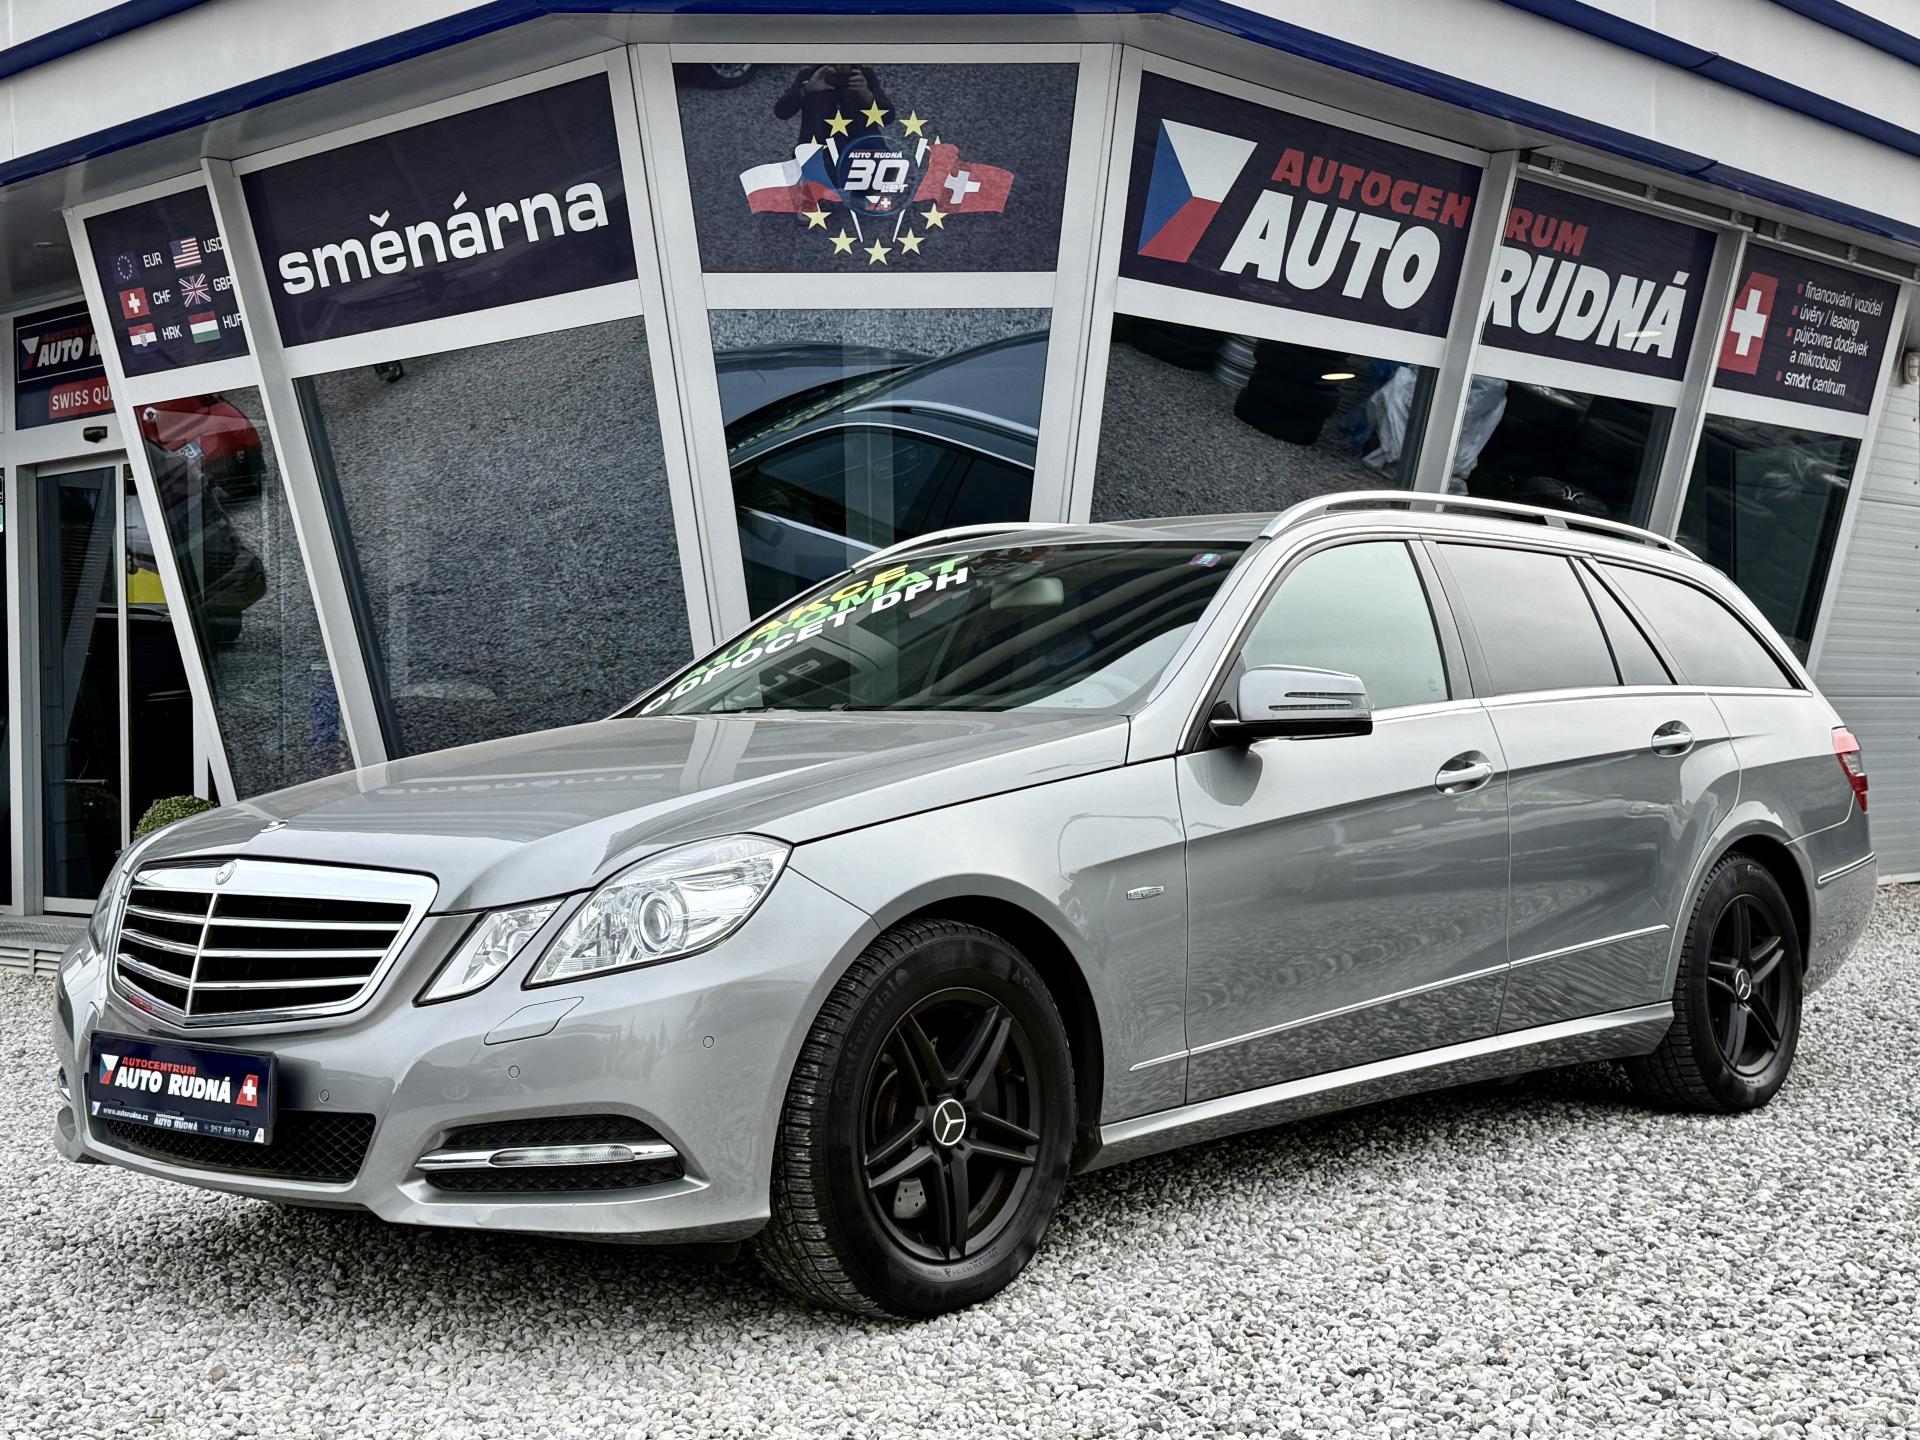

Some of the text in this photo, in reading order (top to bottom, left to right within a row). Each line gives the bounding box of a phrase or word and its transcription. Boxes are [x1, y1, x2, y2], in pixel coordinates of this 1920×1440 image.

[873, 150, 903, 159] RUDNÁ
[843, 159, 910, 191] 30
[278, 182, 608, 295] směnárna
[142, 252, 163, 268] EUR
[1220, 189, 1690, 359] AUTO RUDNÁ
[152, 289, 171, 305] CHF
[1805, 281, 1883, 317] financování vozidel
[162, 325, 182, 341] HRK
[1800, 304, 1824, 328] úvěry
[1830, 310, 1859, 336] leasing
[37, 336, 84, 368] AUTO
[1789, 350, 1797, 363] a
[1793, 325, 1869, 357] půjčovna dodávek
[52, 389, 89, 410] SWISS
[1812, 378, 1847, 396] centrum
[750, 564, 908, 641] AKCE
[871, 567, 969, 614] DPH
[670, 555, 968, 689] AUTOMAT
[122, 1056, 196, 1075] AUTOCENTRUM
[115, 1066, 231, 1104] AUTO RUDNÁ
[153, 1116, 172, 1128] AUTO
[173, 1119, 198, 1131] RUDNÁ
